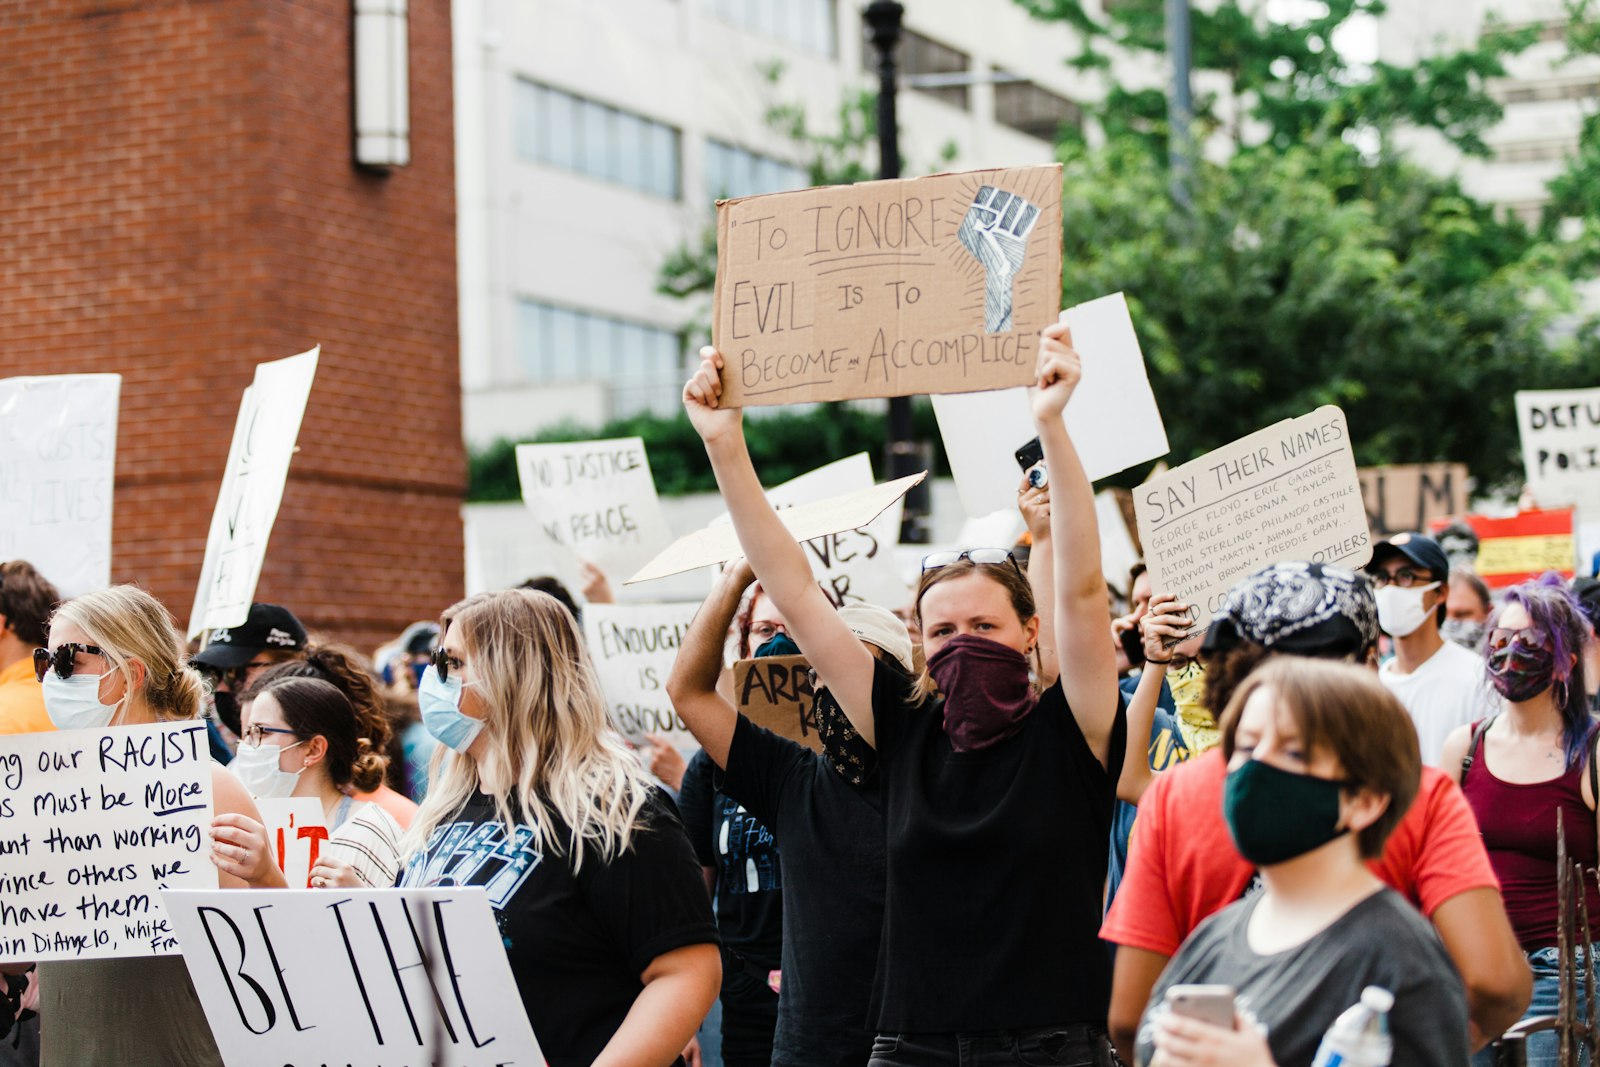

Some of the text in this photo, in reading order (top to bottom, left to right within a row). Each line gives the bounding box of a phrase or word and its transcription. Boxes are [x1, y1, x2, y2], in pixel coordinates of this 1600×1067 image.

[804, 197, 947, 257] IGNORE
[732, 280, 921, 340] EVIL IS TO
[741, 347, 849, 388] BECOME
[562, 449, 641, 485] JUSTICE
[1146, 418, 1343, 524] SAY THEIR NAMES
[30, 477, 107, 527] LIVES
[570, 503, 638, 542] PEACE
[1151, 459, 1334, 550] GEORGE FLOYD ERIC GARNER
[1156, 471, 1337, 563] TAMIR RICE BREONNA TAYLOR
[1161, 484, 1356, 579] ALTON STERLING PHILANDO CASTILLE
[1162, 561, 1214, 592] TRAYVON
[1219, 542, 1255, 565] MARTIN
[1306, 502, 1346, 526] ARBERY
[1312, 532, 1368, 565] OTHERS
[1218, 559, 1252, 582] BROWN
[1264, 532, 1308, 559] FREDDIE
[638, 666, 660, 691] IS
[38, 750, 83, 772] our
[99, 726, 207, 773] RACIST
[101, 783, 134, 811] be
[43, 827, 102, 854] than
[113, 824, 202, 853] working
[68, 863, 138, 886] others
[151, 860, 190, 881] we
[1, 901, 67, 927] have
[196, 896, 497, 1049] BE THE
